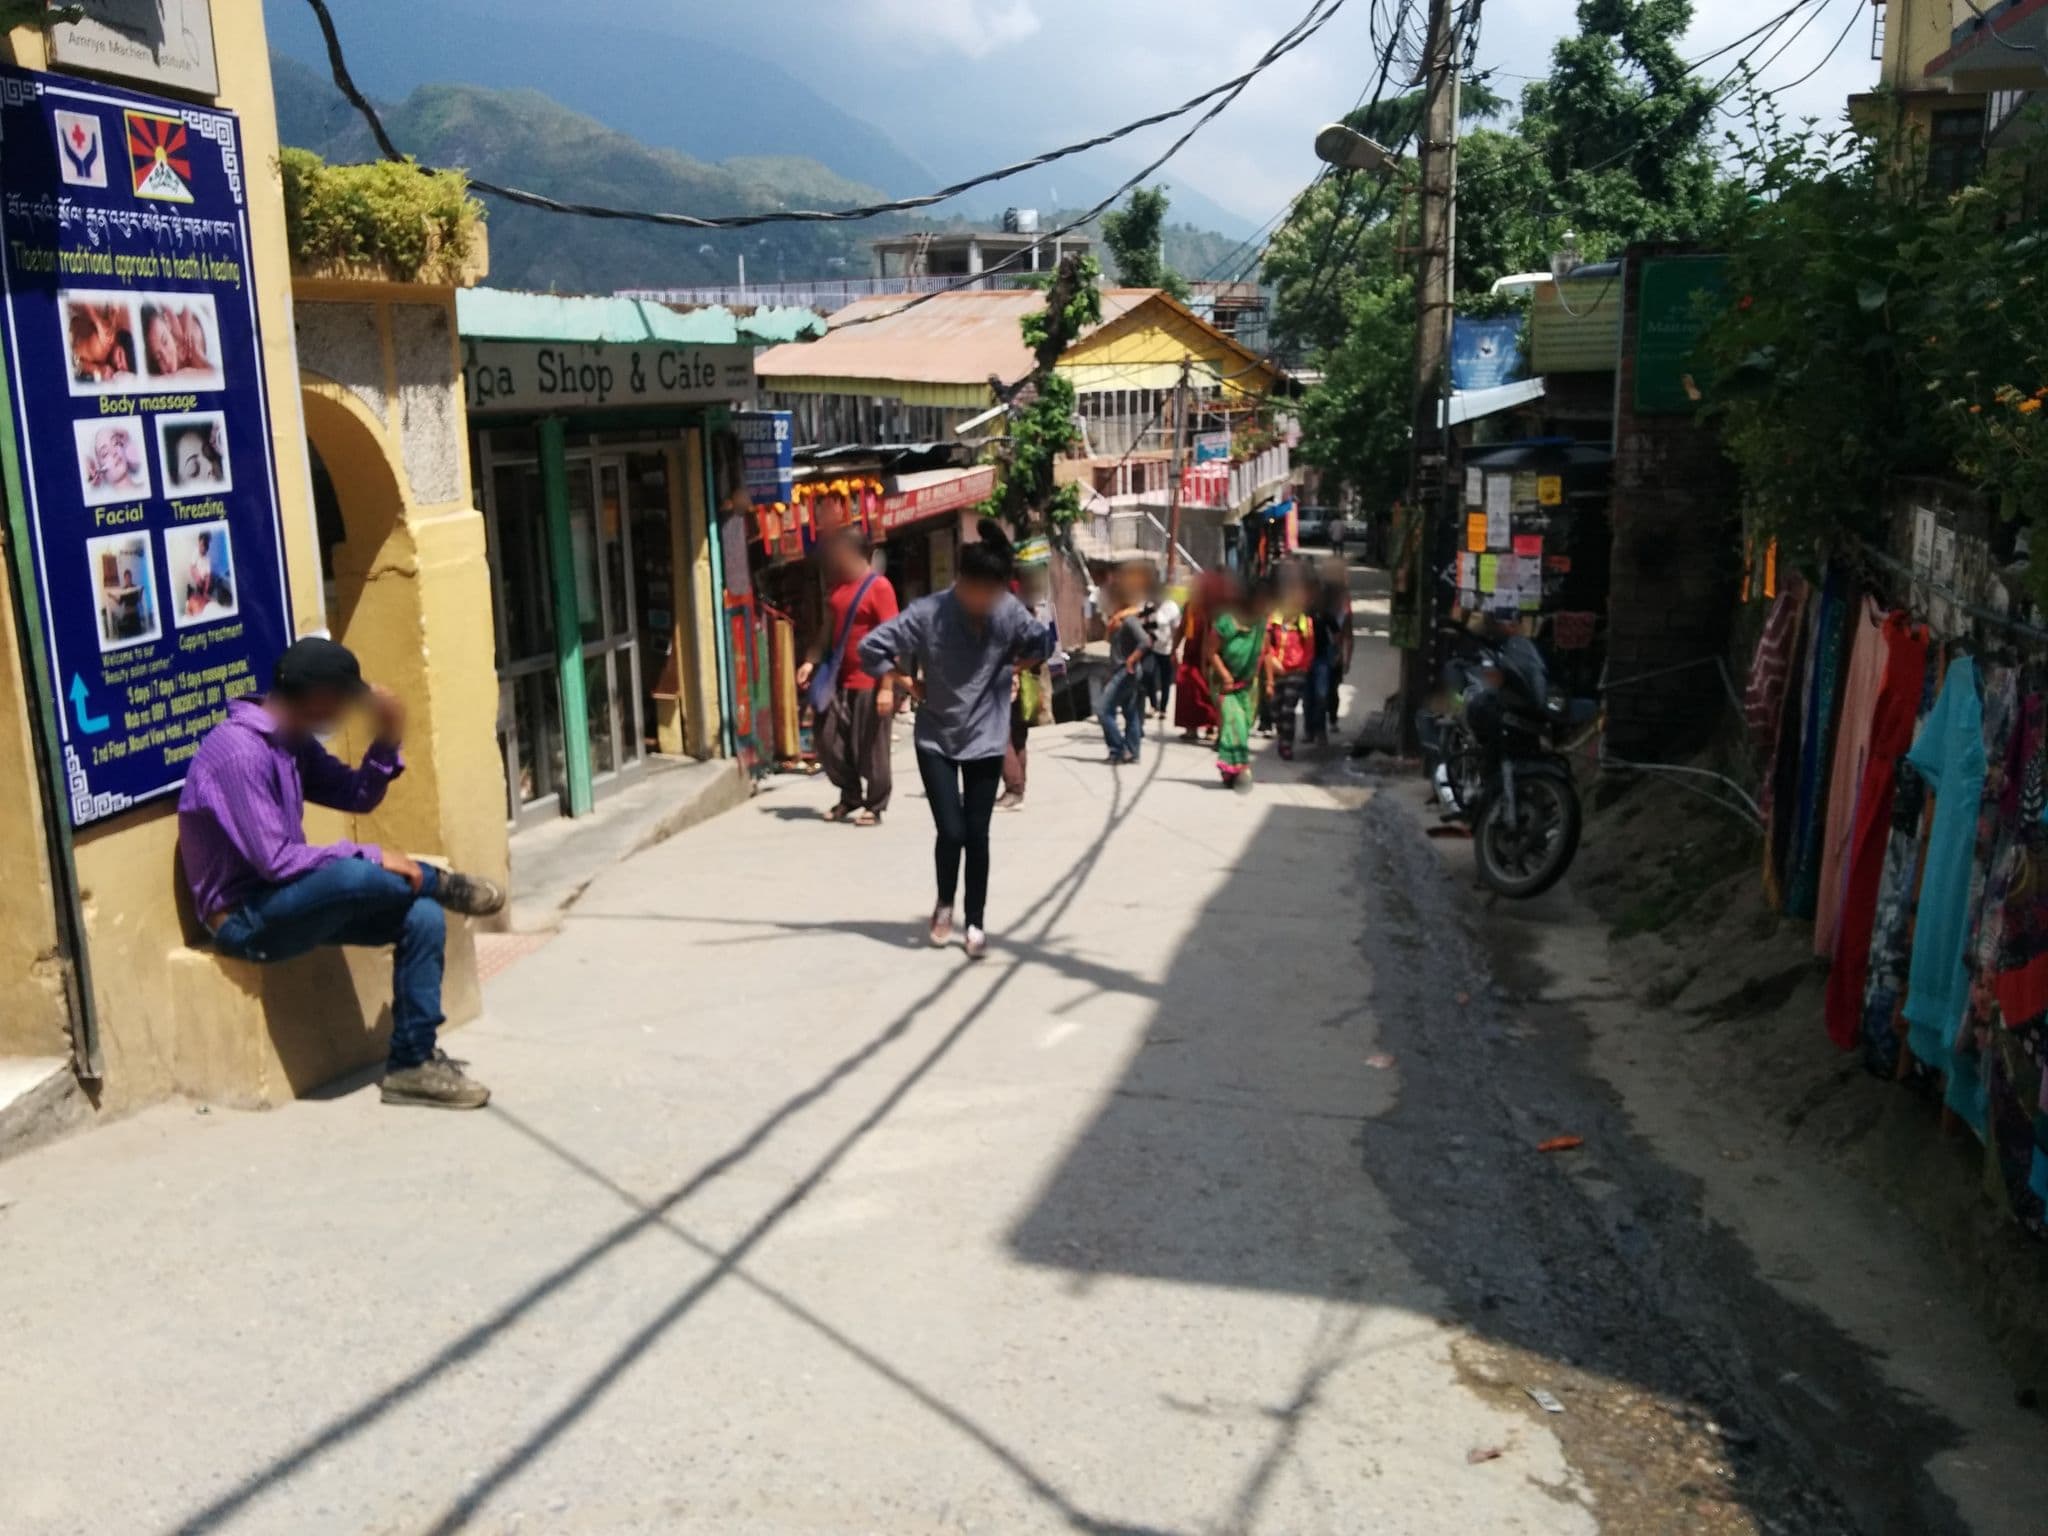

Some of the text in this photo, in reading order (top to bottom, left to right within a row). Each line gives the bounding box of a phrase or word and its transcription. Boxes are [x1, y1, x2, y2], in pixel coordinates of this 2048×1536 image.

[161, 252, 172, 278] to
[537, 350, 614, 403] Shop
[630, 351, 647, 394] &
[99, 393, 198, 416] Body massage
[94, 503, 144, 528] Facial
